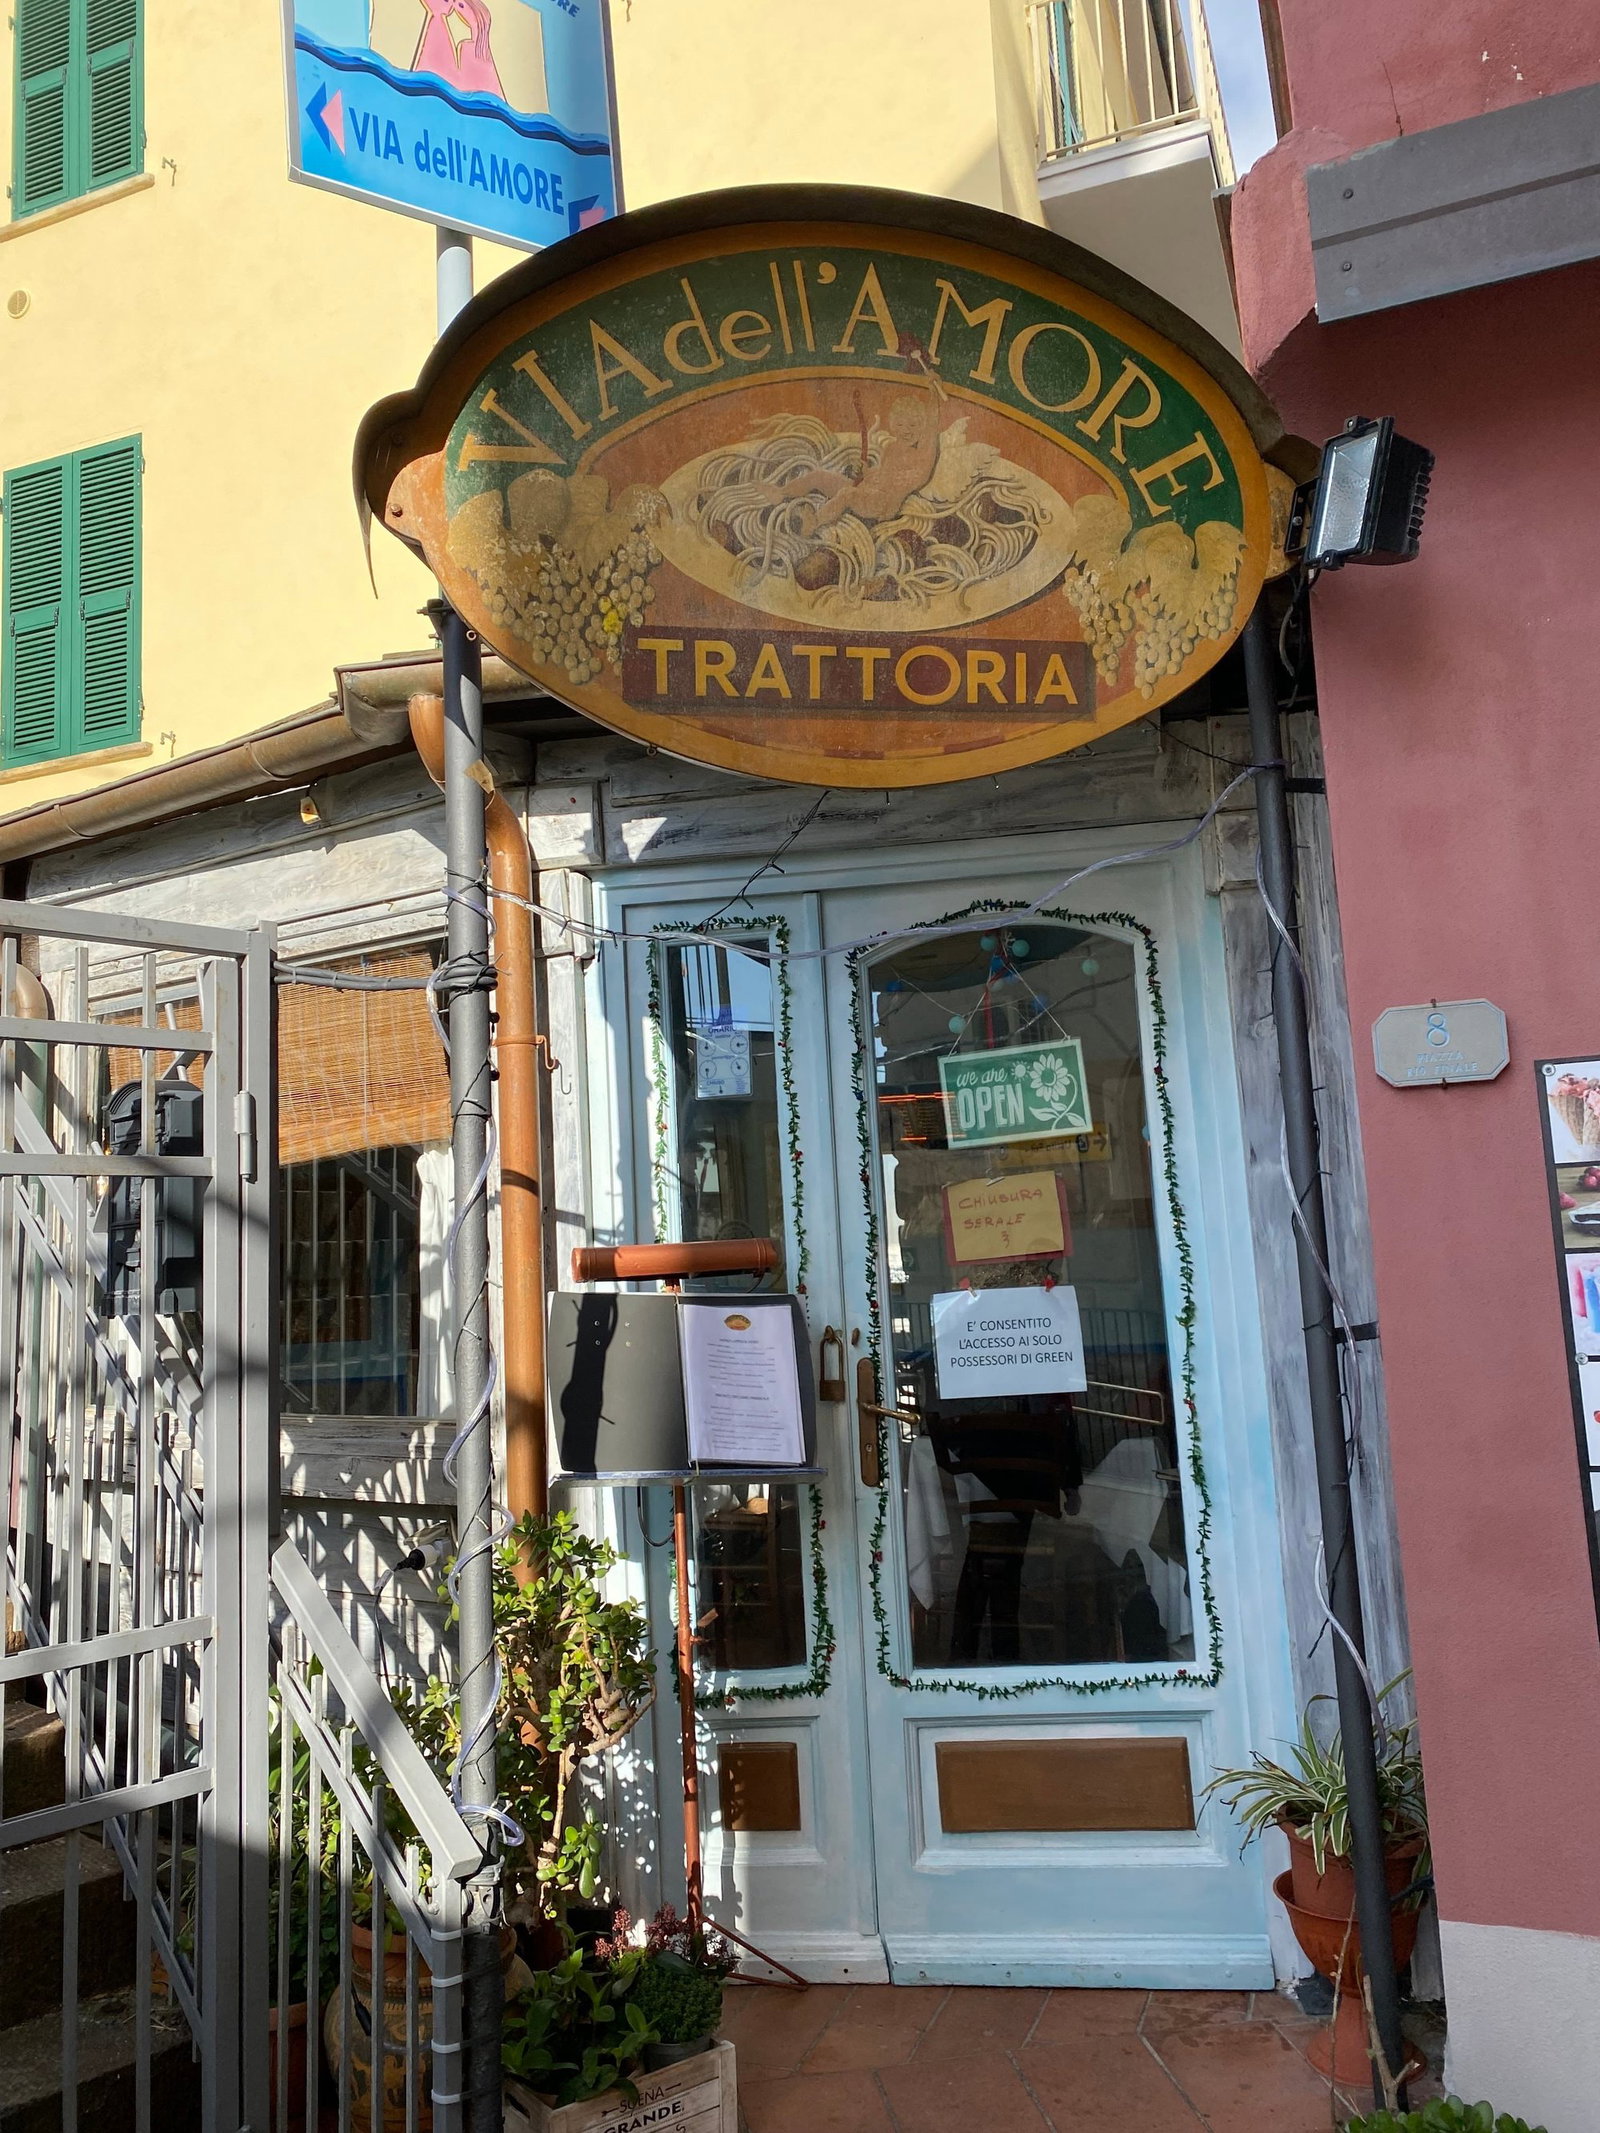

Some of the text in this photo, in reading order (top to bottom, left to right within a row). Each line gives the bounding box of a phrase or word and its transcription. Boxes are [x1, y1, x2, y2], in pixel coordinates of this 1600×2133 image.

[349, 107, 565, 215] VIA dell'AMORE
[637, 638, 1079, 705] TRATTORIA
[1427, 1012, 1450, 1047] 8
[956, 1067, 1008, 1088] we are
[957, 1083, 1026, 1132] OPEN
[963, 1213, 1026, 1230] SERALE
[967, 1317, 1052, 1332] E' CONSENTITO
[959, 1334, 1062, 1350] L'ACCESSO AI SOLO
[950, 1351, 1073, 1368] POSSESSORI DI GREEN
